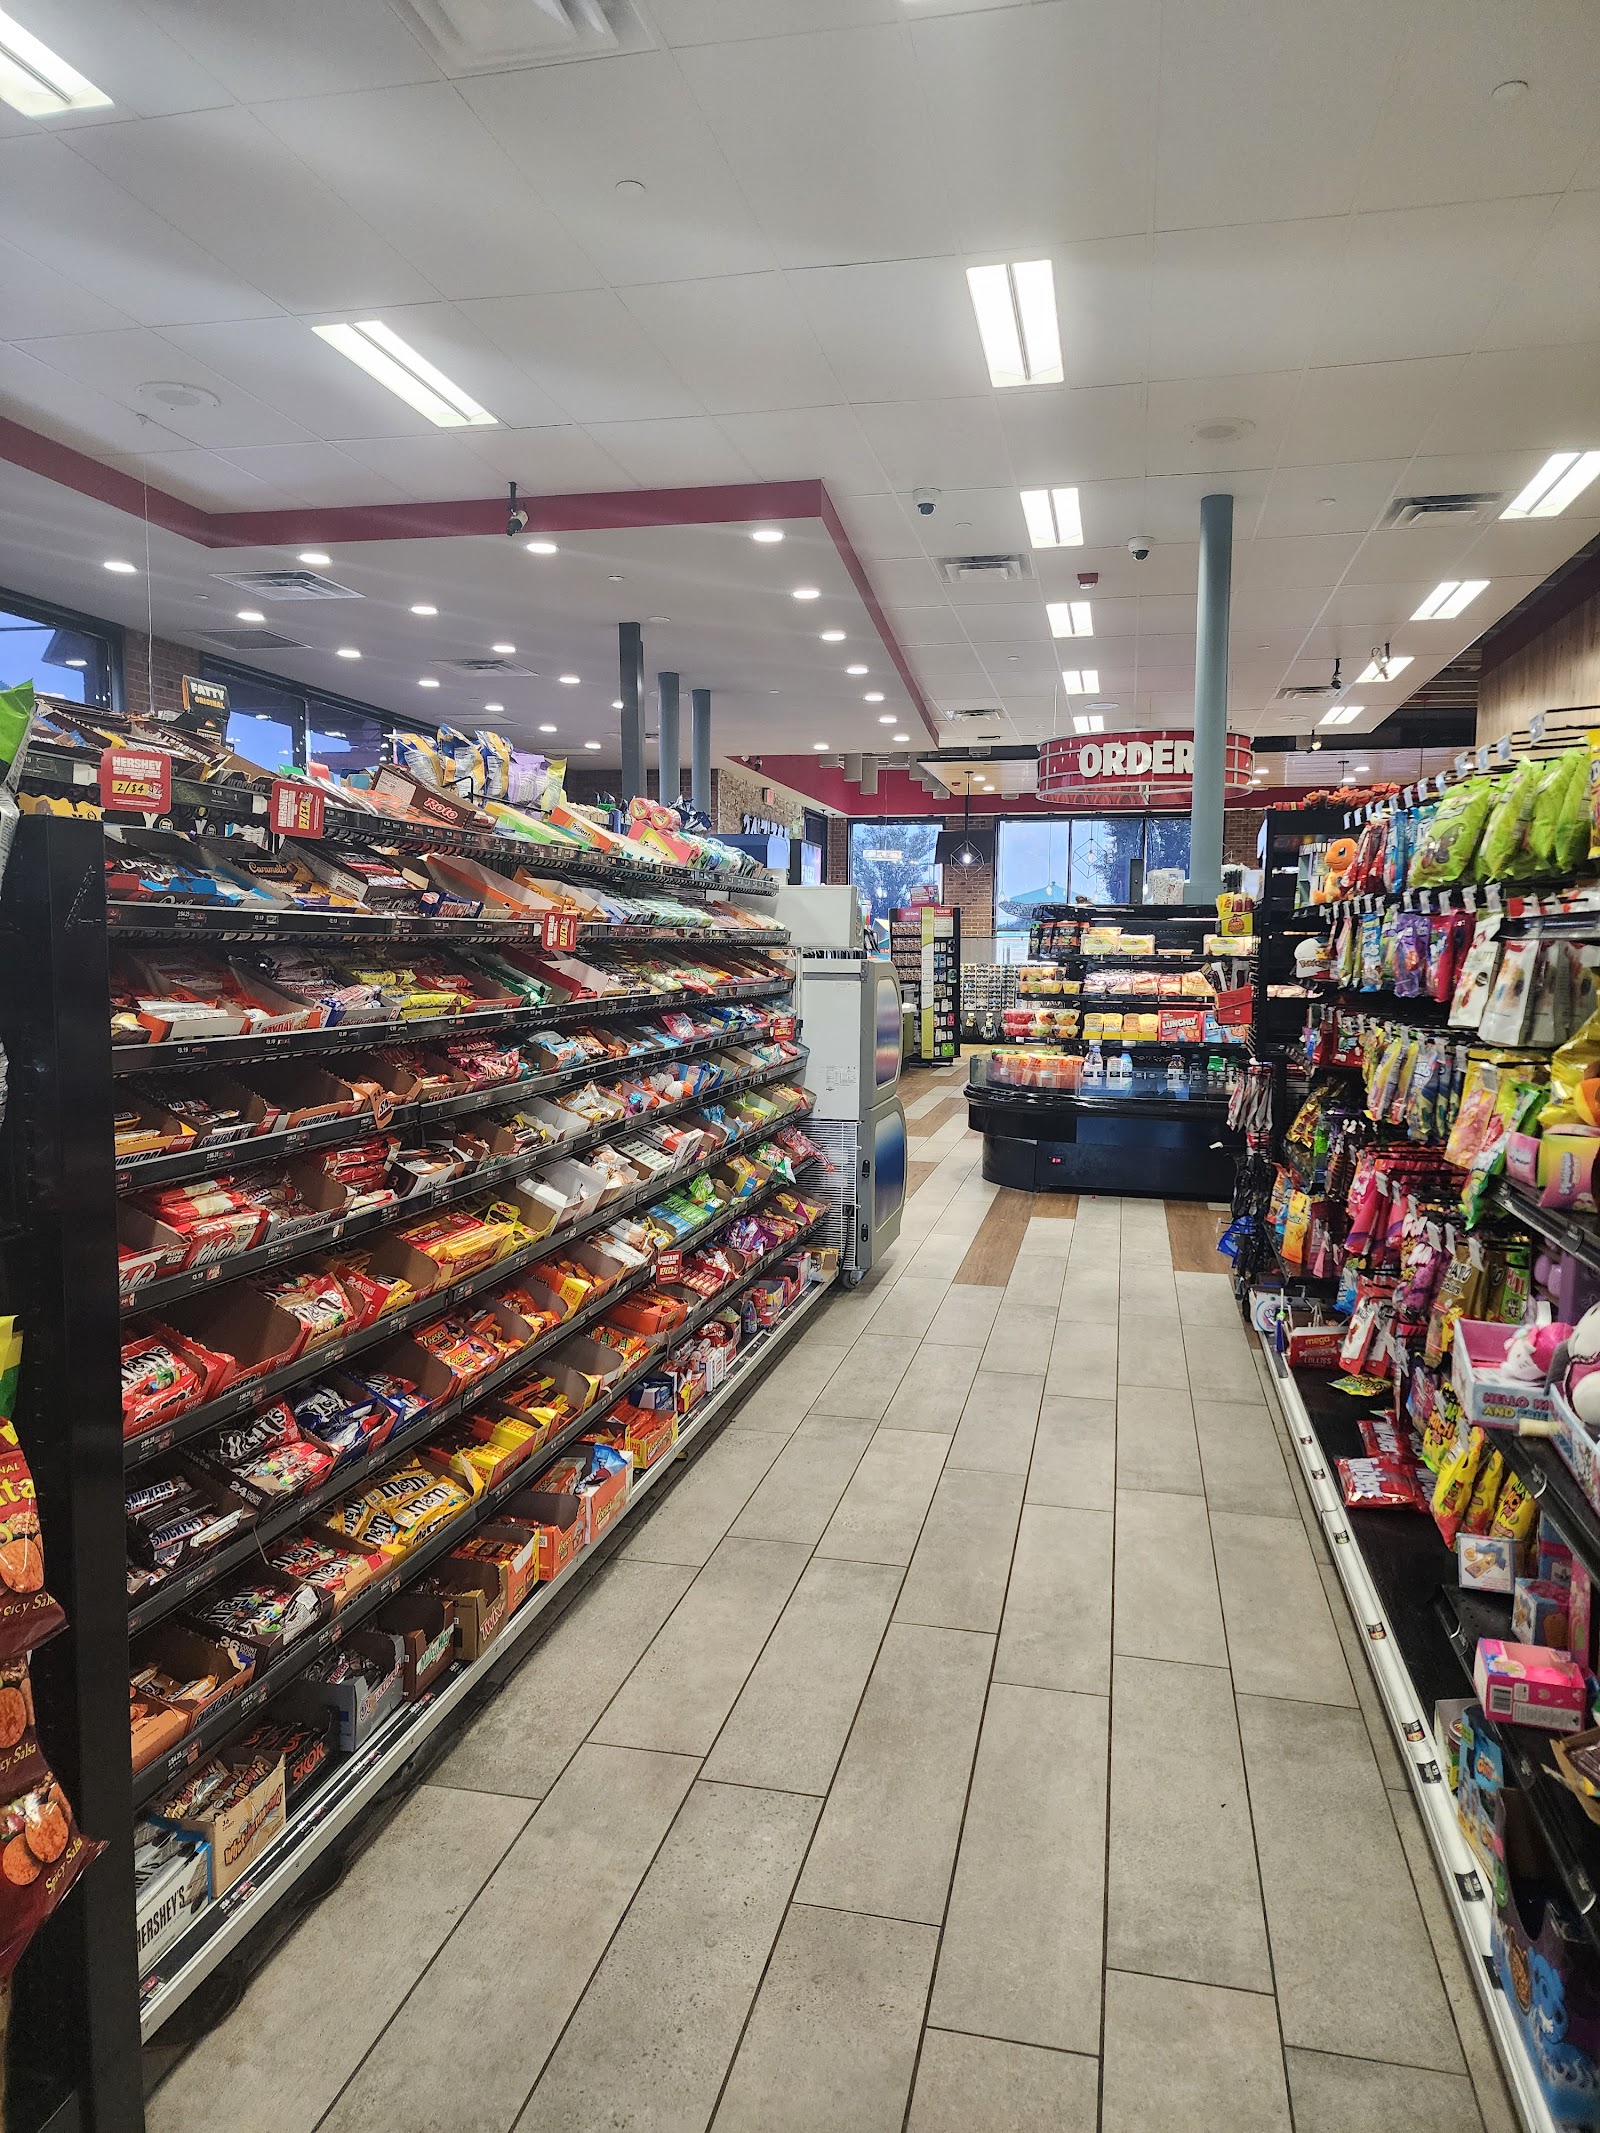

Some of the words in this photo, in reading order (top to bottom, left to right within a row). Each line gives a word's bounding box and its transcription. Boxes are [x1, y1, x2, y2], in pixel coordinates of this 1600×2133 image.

[190, 682, 225, 700] FATTY
[195, 696, 225, 709] ORIGINAL
[112, 756, 162, 770] HERSHEY
[1078, 740, 1195, 777] ORDER
[116, 783, 145, 795] 2/$4
[277, 788, 289, 828] HERSHEY
[423, 797, 459, 820] Rolo
[570, 822, 593, 842] Trident
[248, 862, 288, 875] Caramello
[437, 902, 469, 918] CRUNCH
[1162, 1017, 1198, 1030] LUNCHLY
[165, 1254, 185, 1265] SIZE
[346, 1275, 364, 1291] 24
[565, 1285, 579, 1295] KING
[421, 1330, 447, 1348] Reese's
[1305, 1335, 1335, 1347] mega
[444, 1349, 472, 1366] Reese's
[1303, 1357, 1332, 1365] LOLLIES
[1483, 1392, 1529, 1408] HELLO
[1482, 1406, 1515, 1419] AND
[124, 1481, 172, 1511] SNICKERS
[229, 1480, 248, 1499] 24
[380, 1474, 432, 1500] m&m's
[402, 1483, 452, 1518] m&m's
[150, 1518, 202, 1546] SNICKERS
[480, 1606, 503, 1641] Twix
[219, 1636, 240, 1651] 36
[416, 1641, 440, 1677] Milky
[437, 1624, 455, 1650] Way
[14, 1742, 38, 1764] Salsa
[291, 1740, 327, 1786] SKOR
[223, 1783, 284, 1868] Whatchamacallit
[45, 1855, 68, 1895] Spicy
[65, 1836, 84, 1865] Salsa
[136, 1884, 186, 1954] HERSHEY'S
